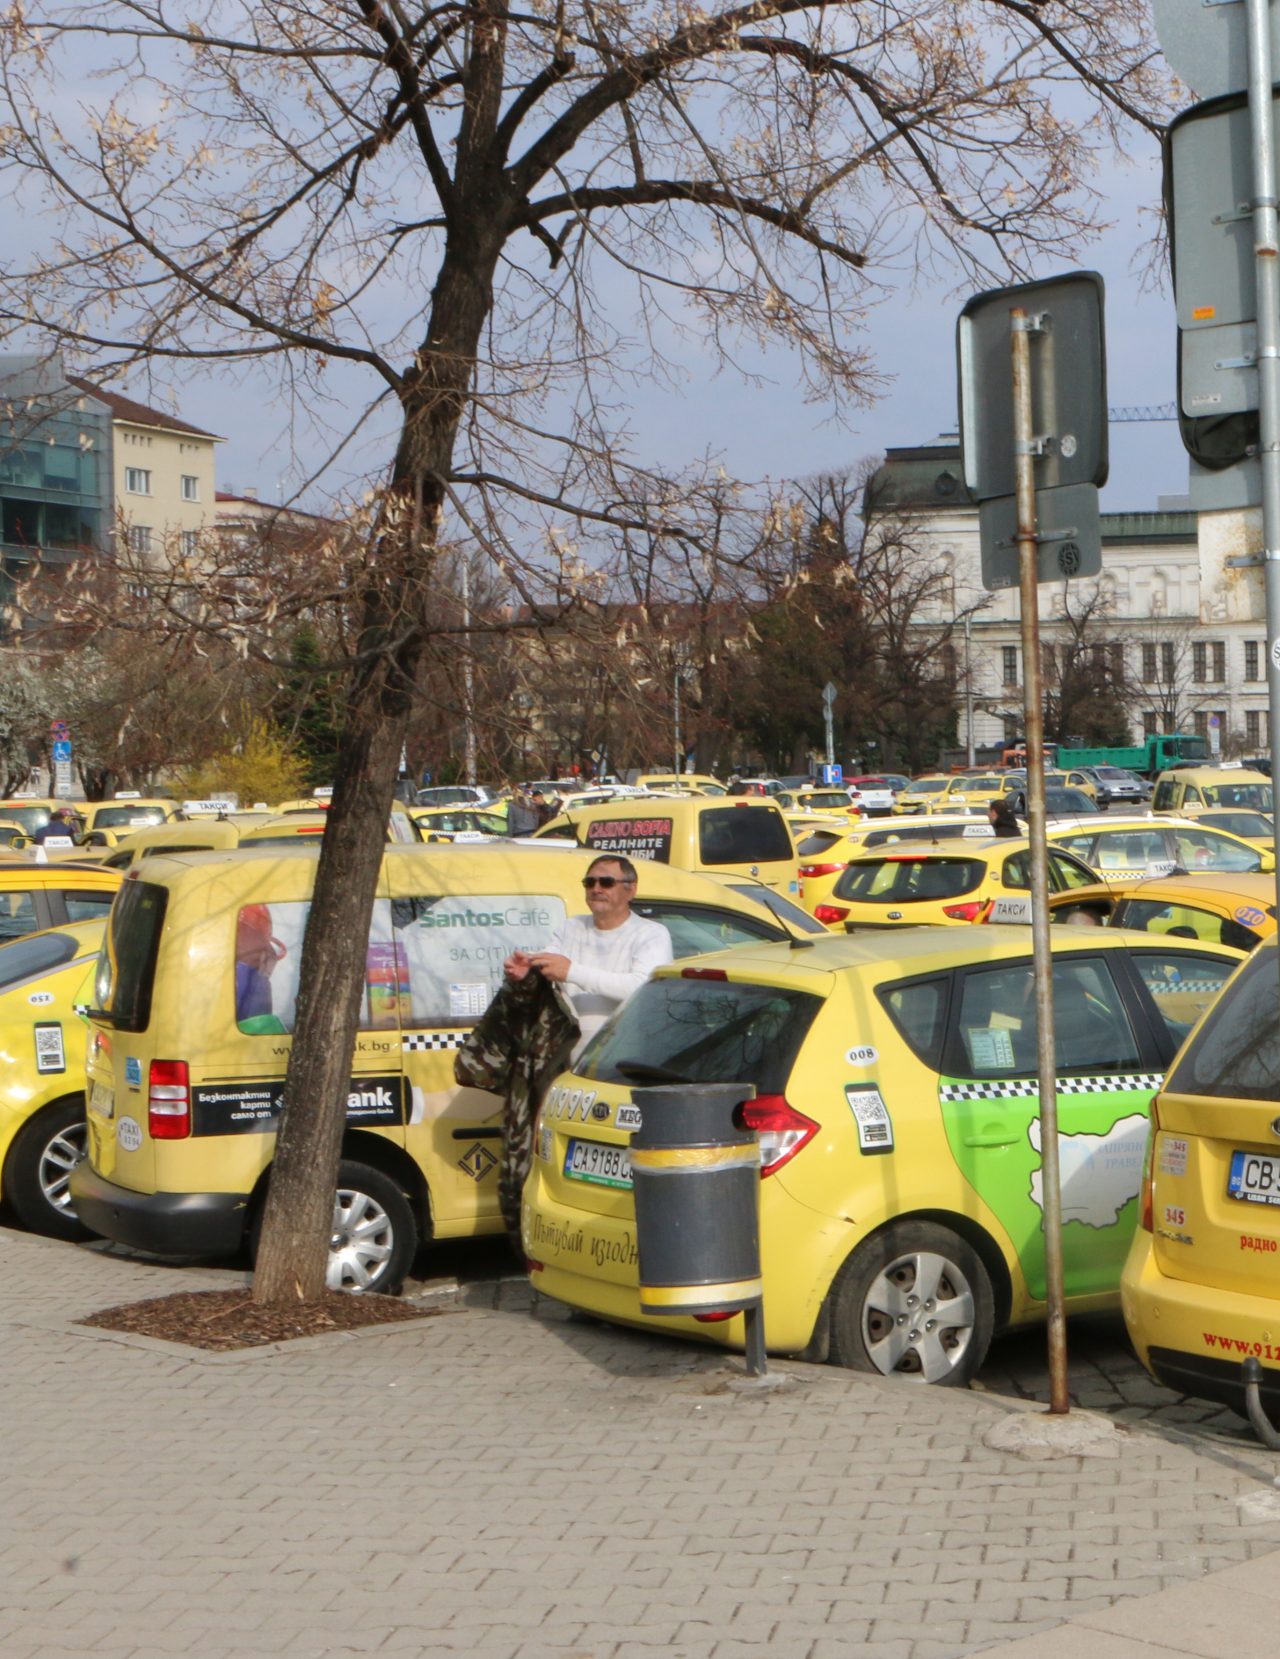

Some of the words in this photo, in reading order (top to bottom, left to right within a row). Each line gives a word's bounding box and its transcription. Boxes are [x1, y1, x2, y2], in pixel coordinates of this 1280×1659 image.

[199, 802, 228, 810] ТАКСИ
[589, 820, 632, 838] CASINO
[633, 819, 671, 836] SOFIA
[593, 838, 663, 850] РЕАЛНИТЕ
[997, 903, 1026, 916] ТАКСИ
[1236, 907, 1266, 925] 010
[419, 908, 551, 928] SantosCafé
[450, 947, 471, 961] ЗА
[850, 1048, 875, 1061] 008
[199, 1091, 271, 1103] Безконтактни
[347, 1087, 393, 1108] ank
[240, 1101, 271, 1111] карти
[231, 1112, 255, 1120] само
[257, 1111, 271, 1119] от
[618, 1108, 642, 1124] MEG
[1166, 1208, 1185, 1225] 345
[533, 1214, 583, 1256] Пътувай
[591, 1232, 639, 1266] изгодн
[1240, 1234, 1277, 1252] радио
